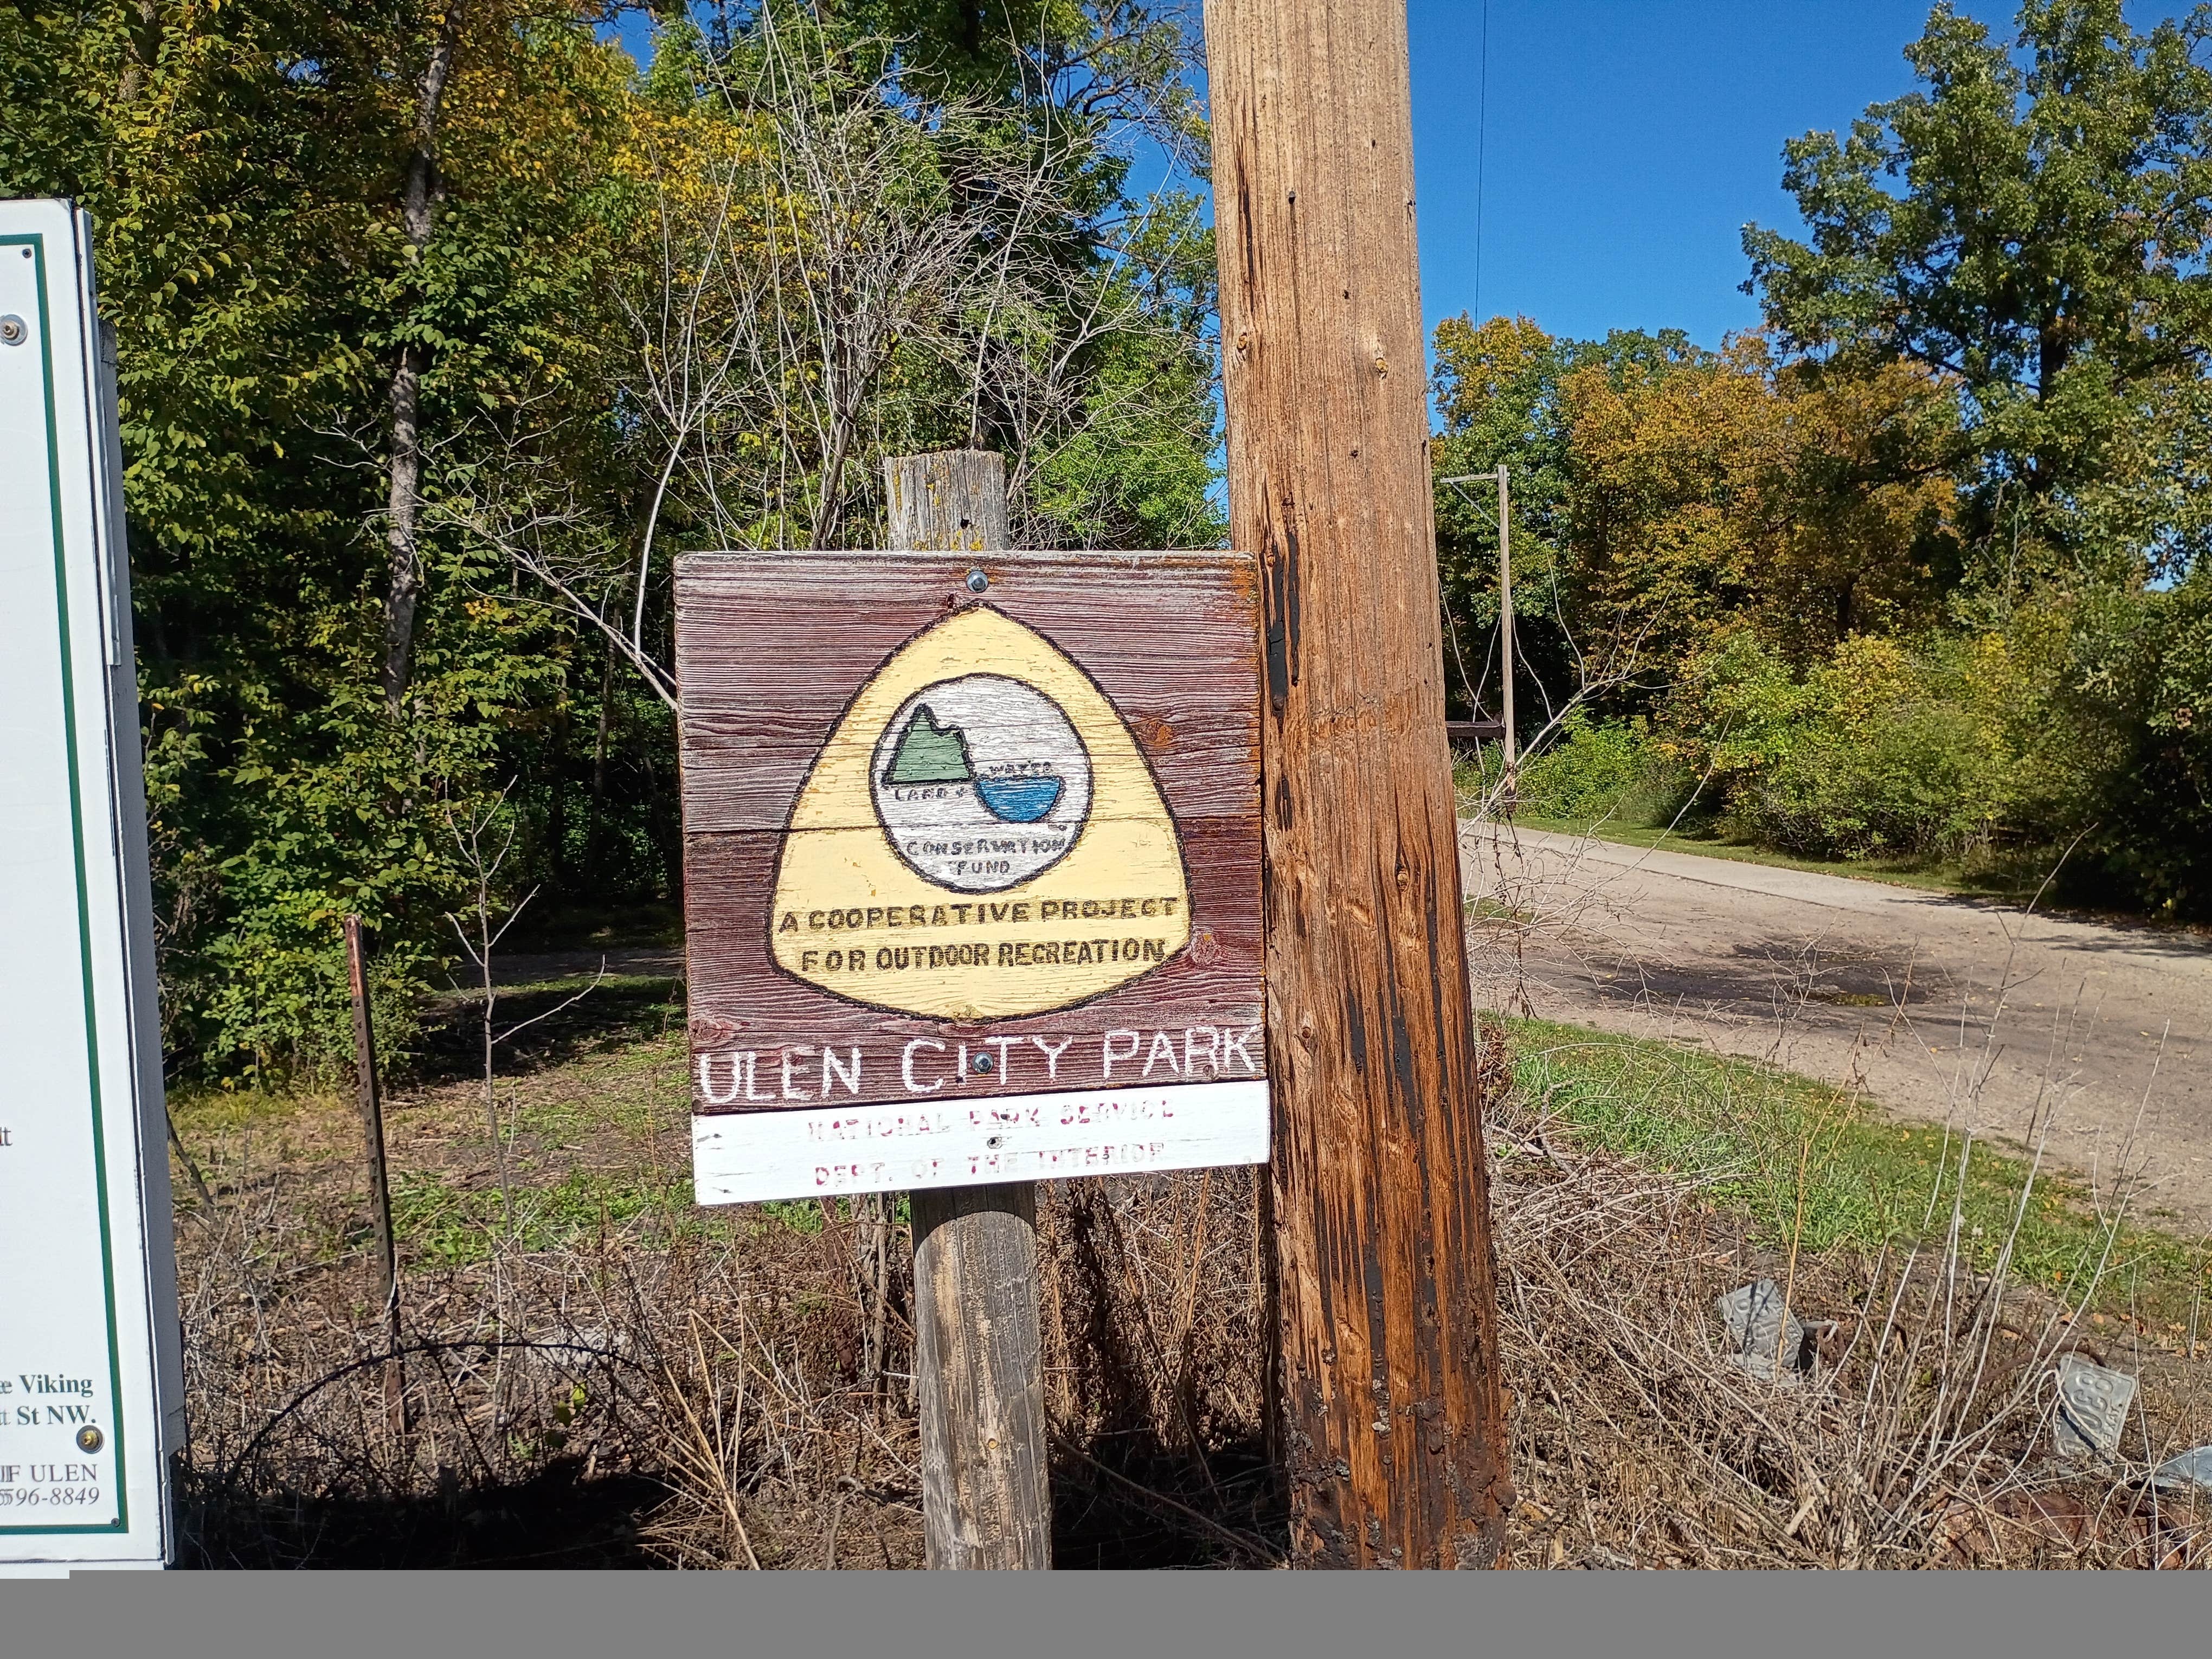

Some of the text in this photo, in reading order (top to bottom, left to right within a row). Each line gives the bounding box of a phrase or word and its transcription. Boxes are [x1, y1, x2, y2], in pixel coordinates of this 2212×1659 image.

[895, 787, 947, 801] LAND
[906, 838, 1066, 856] CONSERVATION
[956, 859, 1010, 876] FUND
[779, 896, 1178, 933] A COOPERATIVE PROJECT
[802, 937, 1165, 972] FOR OUTDOOR RECREATION
[699, 1024, 1258, 1104] ULEN CITY PARK
[808, 1098, 1174, 1141] NATIONAL PARK SERVICE
[911, 1158, 944, 1180] OF
[967, 1153, 1018, 1174] THE
[1038, 1141, 1165, 1170] INTERIOR
[18, 1373, 94, 1398] Viking
[17, 1405, 41, 1425] St
[46, 1405, 97, 1425] NW.
[29, 1463, 98, 1483] ULEN
